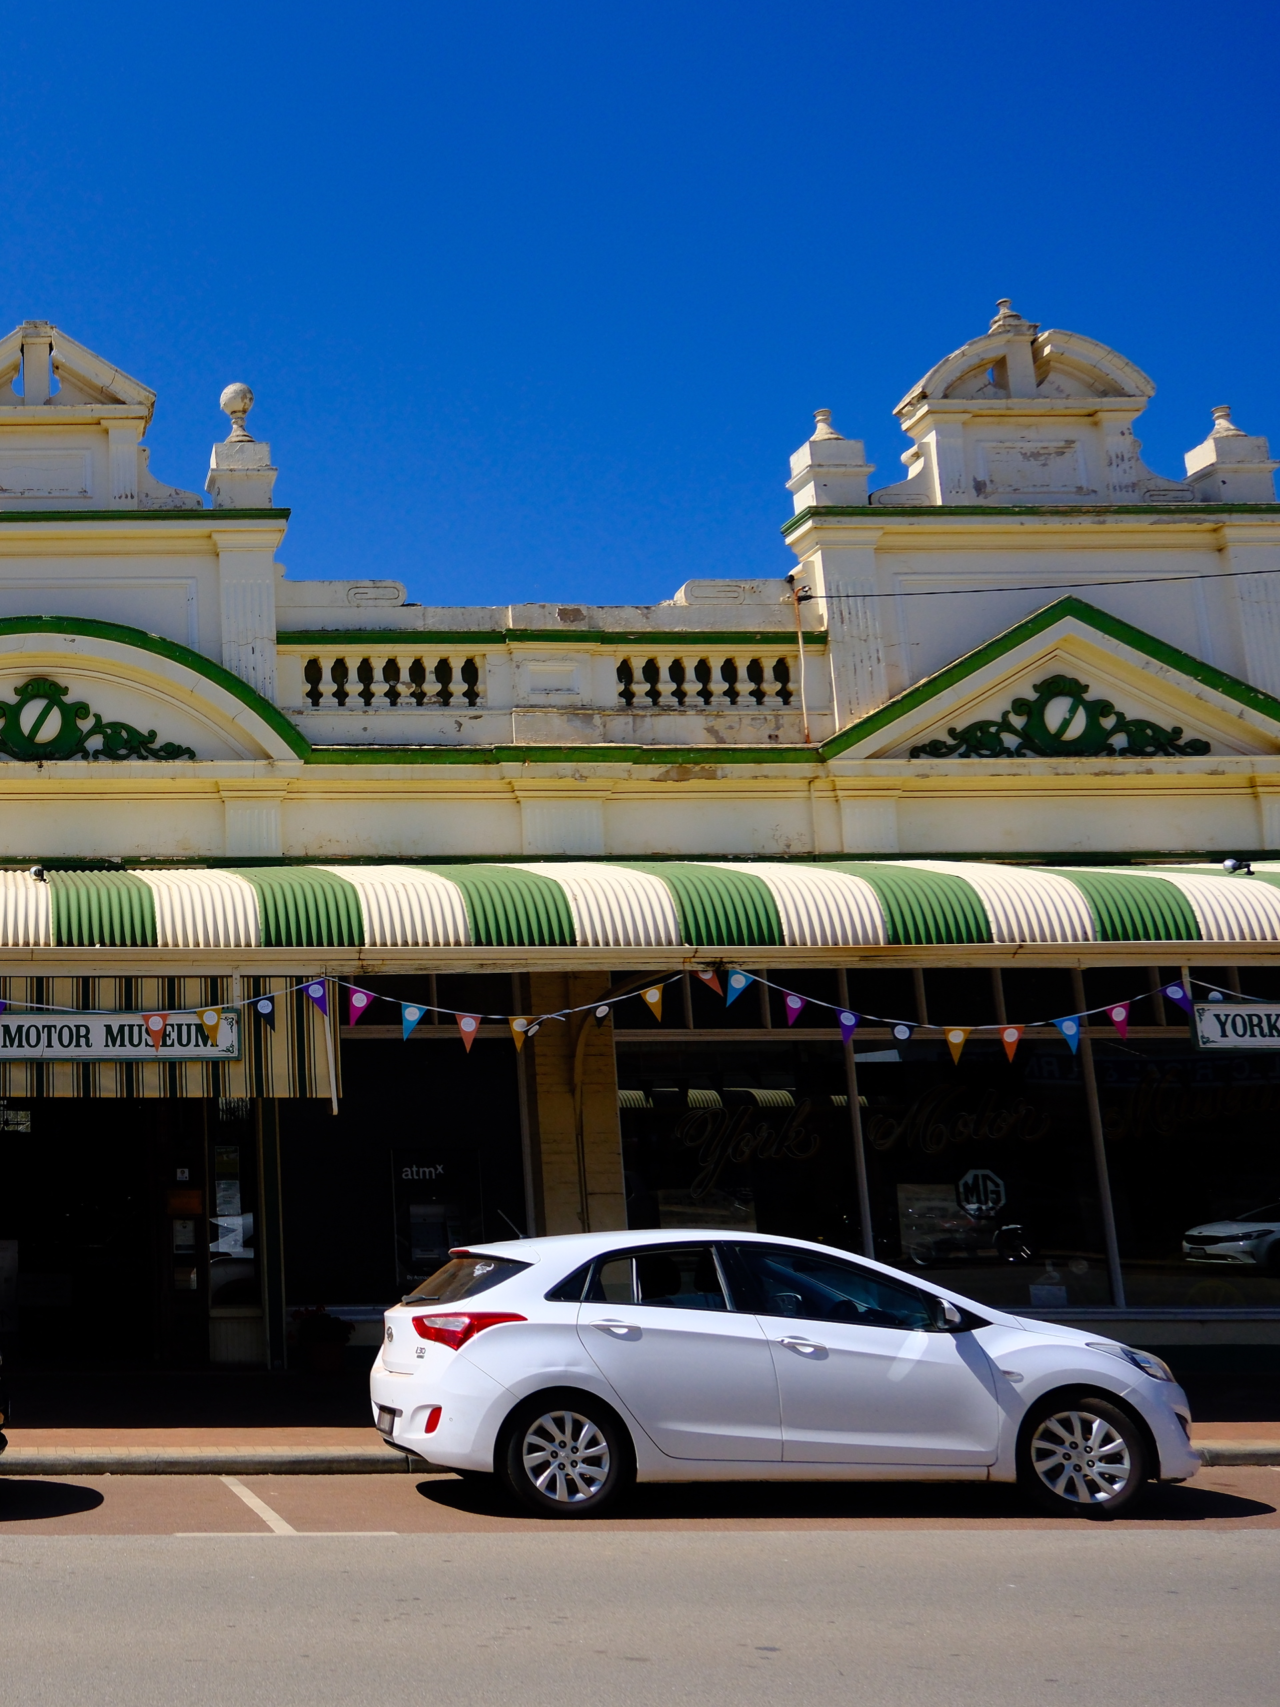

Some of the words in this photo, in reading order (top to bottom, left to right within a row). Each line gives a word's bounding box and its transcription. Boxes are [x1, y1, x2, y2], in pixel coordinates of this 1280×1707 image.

[1, 1024, 93, 1049] MOTOR
[1213, 1013, 1280, 1038] YORK
[675, 1098, 820, 1198] York
[962, 1173, 1002, 1206] MG
